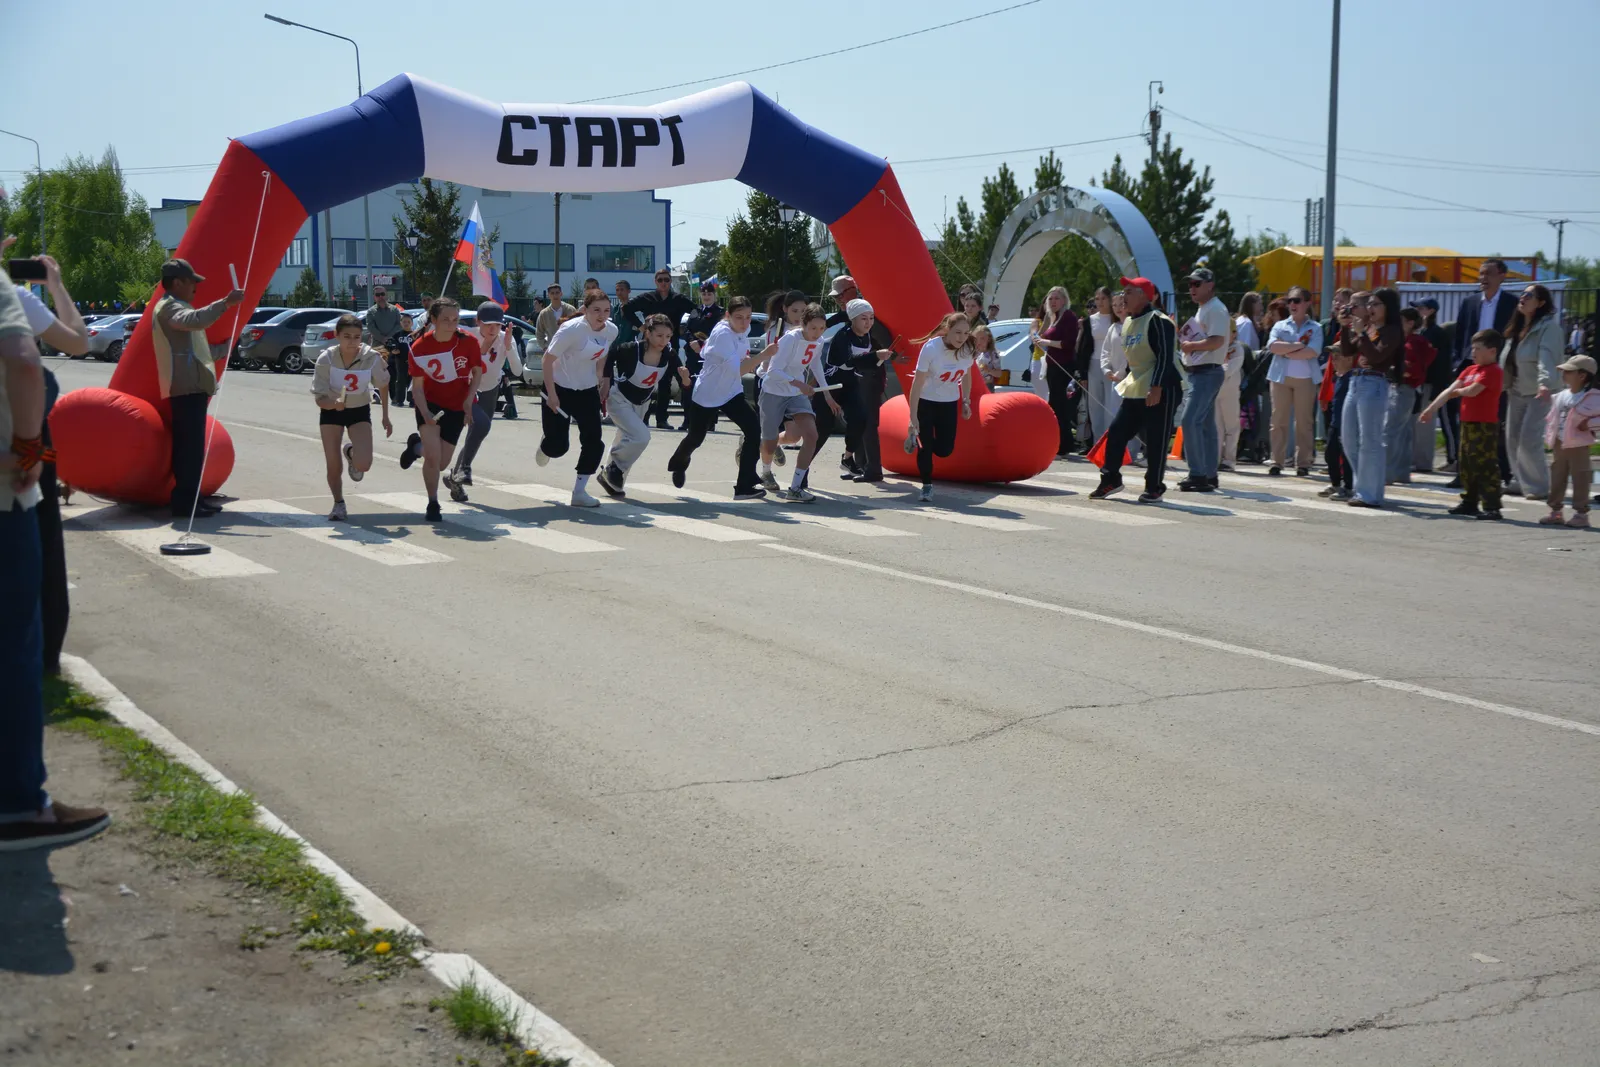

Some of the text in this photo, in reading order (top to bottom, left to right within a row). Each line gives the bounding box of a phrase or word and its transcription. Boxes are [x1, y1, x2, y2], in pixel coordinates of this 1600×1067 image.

[496, 114, 685, 168] СТАРТ
[802, 344, 817, 365] 5
[427, 358, 445, 381] 2
[641, 371, 659, 387] 4
[343, 373, 359, 392] 3
